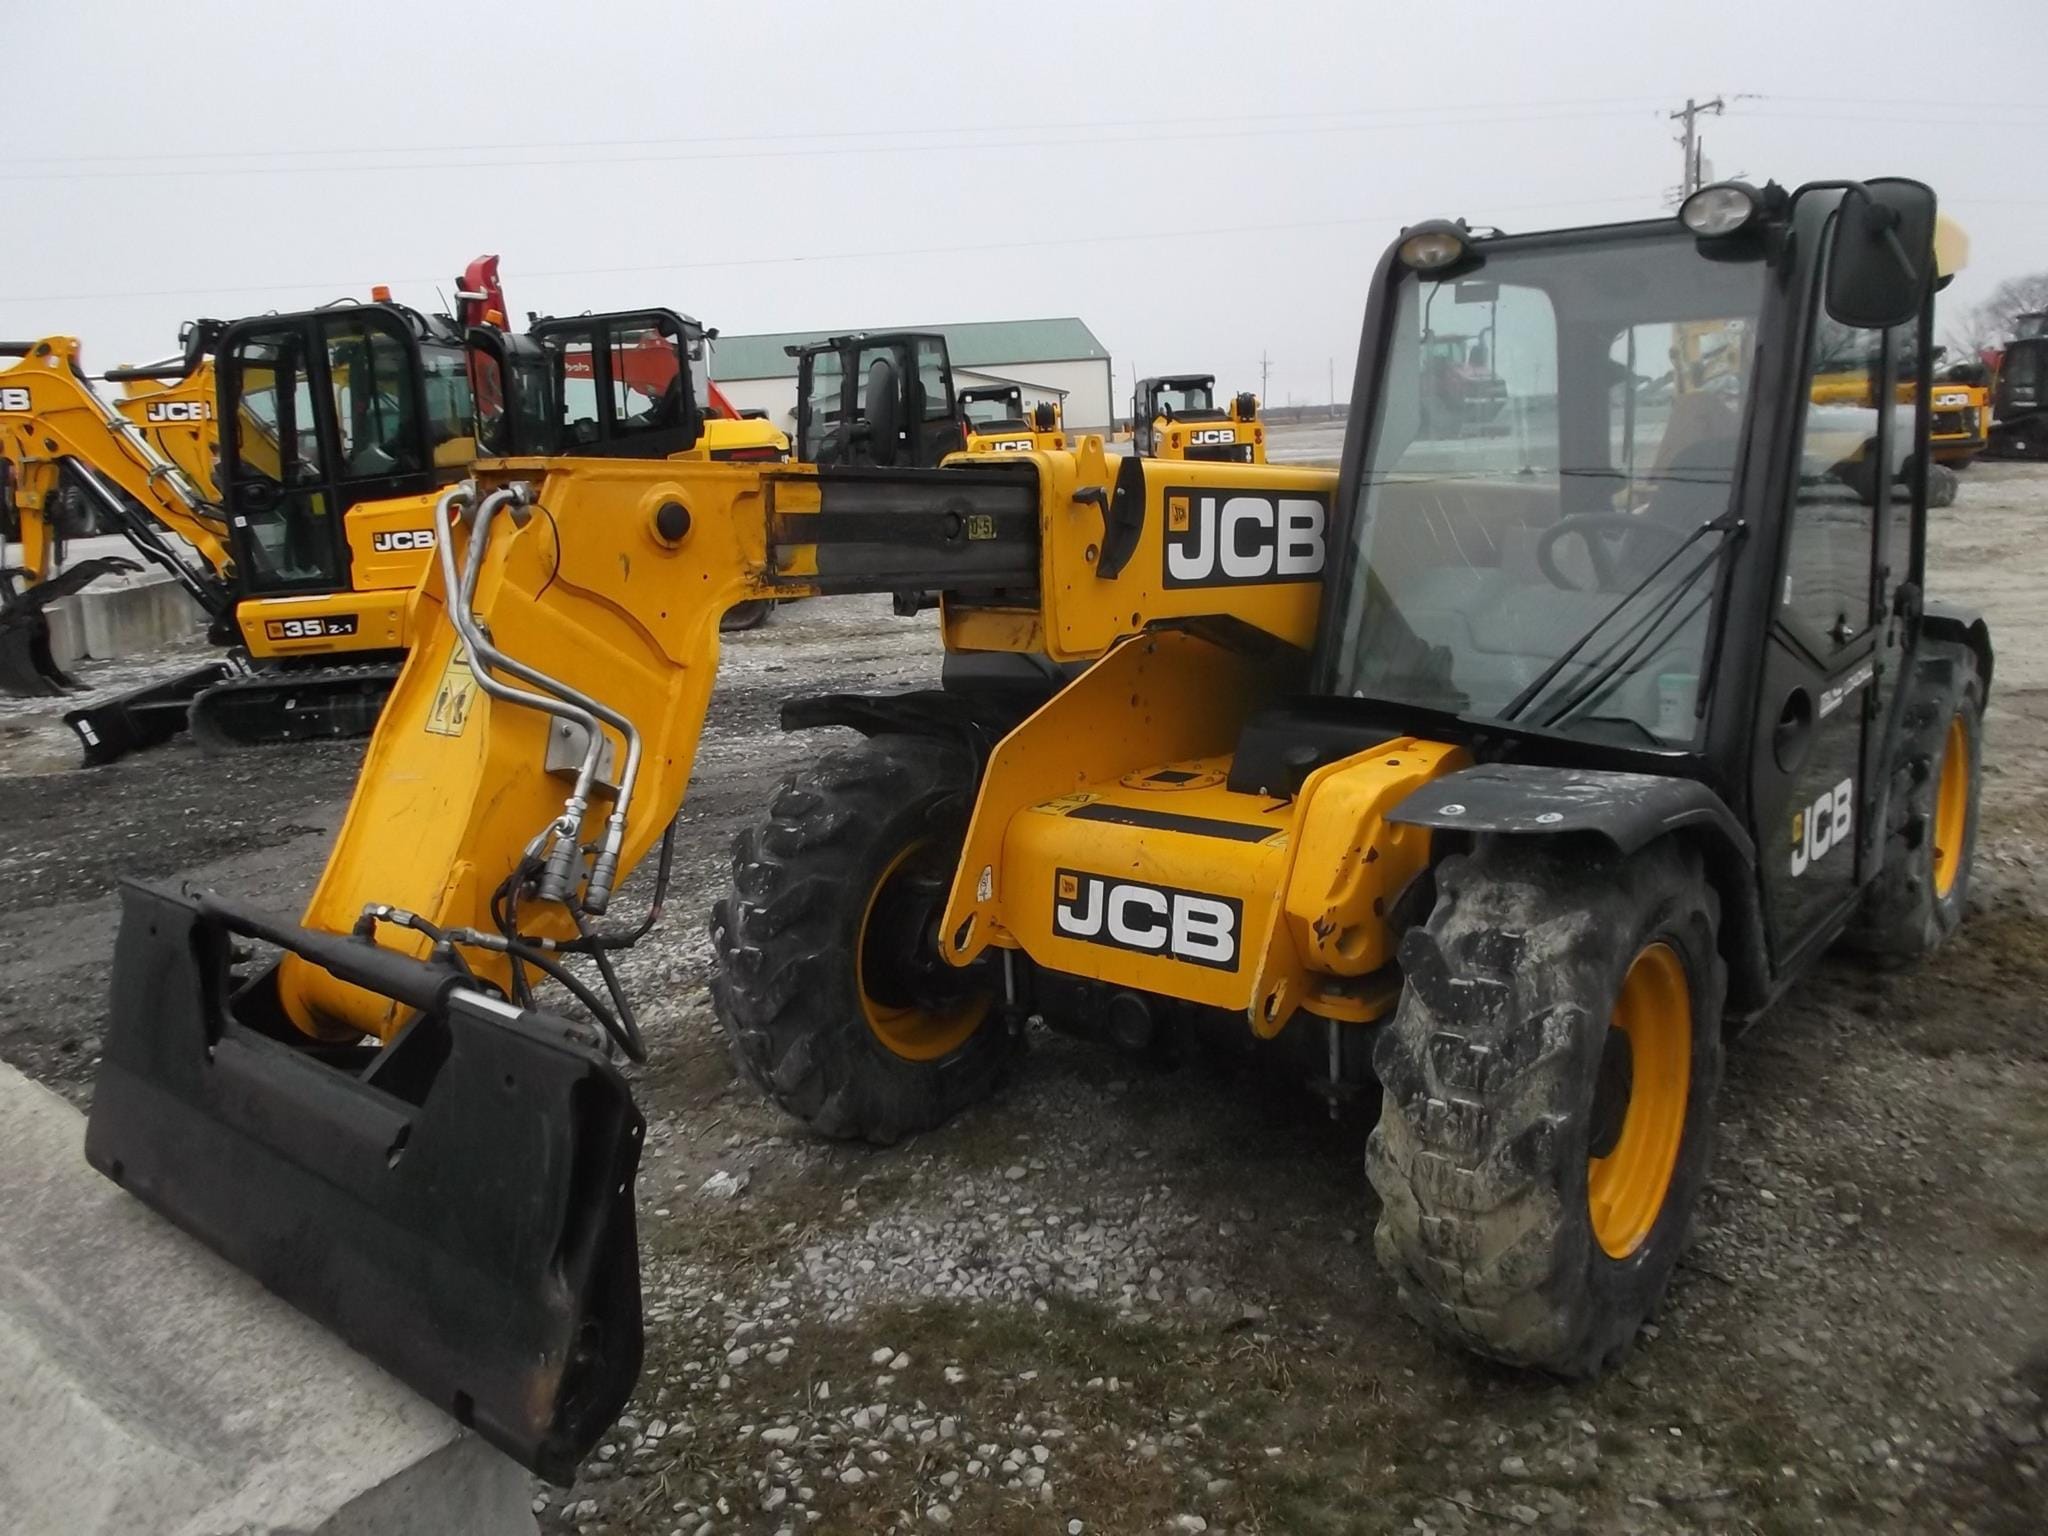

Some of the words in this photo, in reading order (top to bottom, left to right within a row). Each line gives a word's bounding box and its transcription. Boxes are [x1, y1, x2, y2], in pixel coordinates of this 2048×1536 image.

[0, 388, 30, 411] B
[148, 402, 211, 421] JCB
[1192, 429, 1235, 444] JCB
[375, 530, 435, 551] JCB
[1168, 497, 1326, 580] JCB
[284, 619, 322, 638] 35
[329, 623, 353, 635] Z-1
[1791, 777, 1853, 878] JCB
[1057, 878, 1235, 963] JCB
